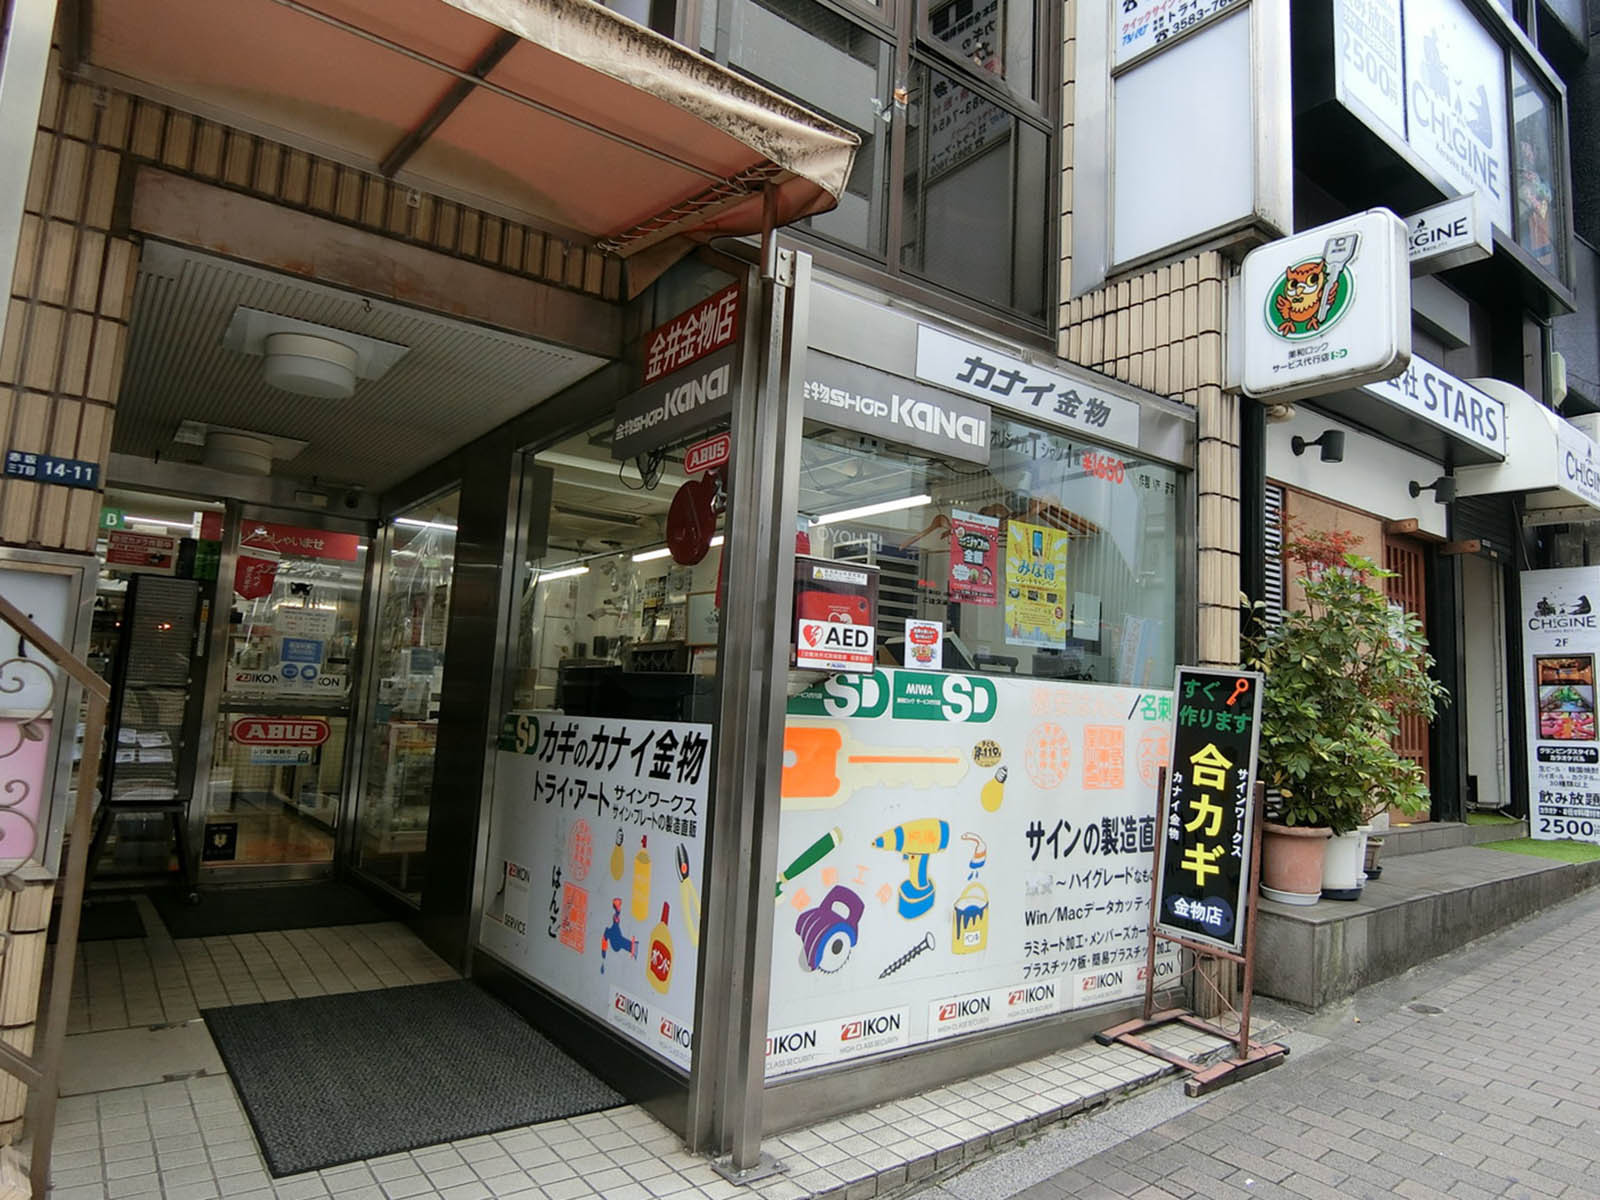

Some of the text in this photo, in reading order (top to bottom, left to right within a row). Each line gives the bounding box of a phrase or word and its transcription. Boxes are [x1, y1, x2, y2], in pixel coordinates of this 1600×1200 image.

[646, 290, 738, 380] 金井金物店
[1272, 353, 1330, 373] サービス代行店
[955, 356, 1112, 428] カナイ金物
[1423, 373, 1498, 441] STARS
[690, 440, 725, 467] ABUS
[44, 461, 93, 481] 14-11
[825, 626, 869, 648] AED
[1554, 637, 1569, 648] 2F
[906, 682, 934, 696] MIWA
[1183, 678, 1221, 702] すぐ
[245, 724, 318, 740] ABUS
[1179, 704, 1252, 734] 作ります
[538, 721, 708, 785] カギのカナイ金物
[533, 770, 610, 816] トライ・アート
[614, 784, 697, 816] サインワークス
[1168, 771, 1184, 841] カナイ金物
[1539, 790, 1600, 806] 飲み放題
[1180, 743, 1234, 887] 合カギ
[1231, 768, 1251, 857] サインワークス
[1540, 818, 1594, 836] 2500
[1026, 814, 1155, 861] サインの製造直
[547, 865, 562, 939] はんこ
[1173, 897, 1224, 927] 金物店
[504, 913, 527, 936] SERVICE
